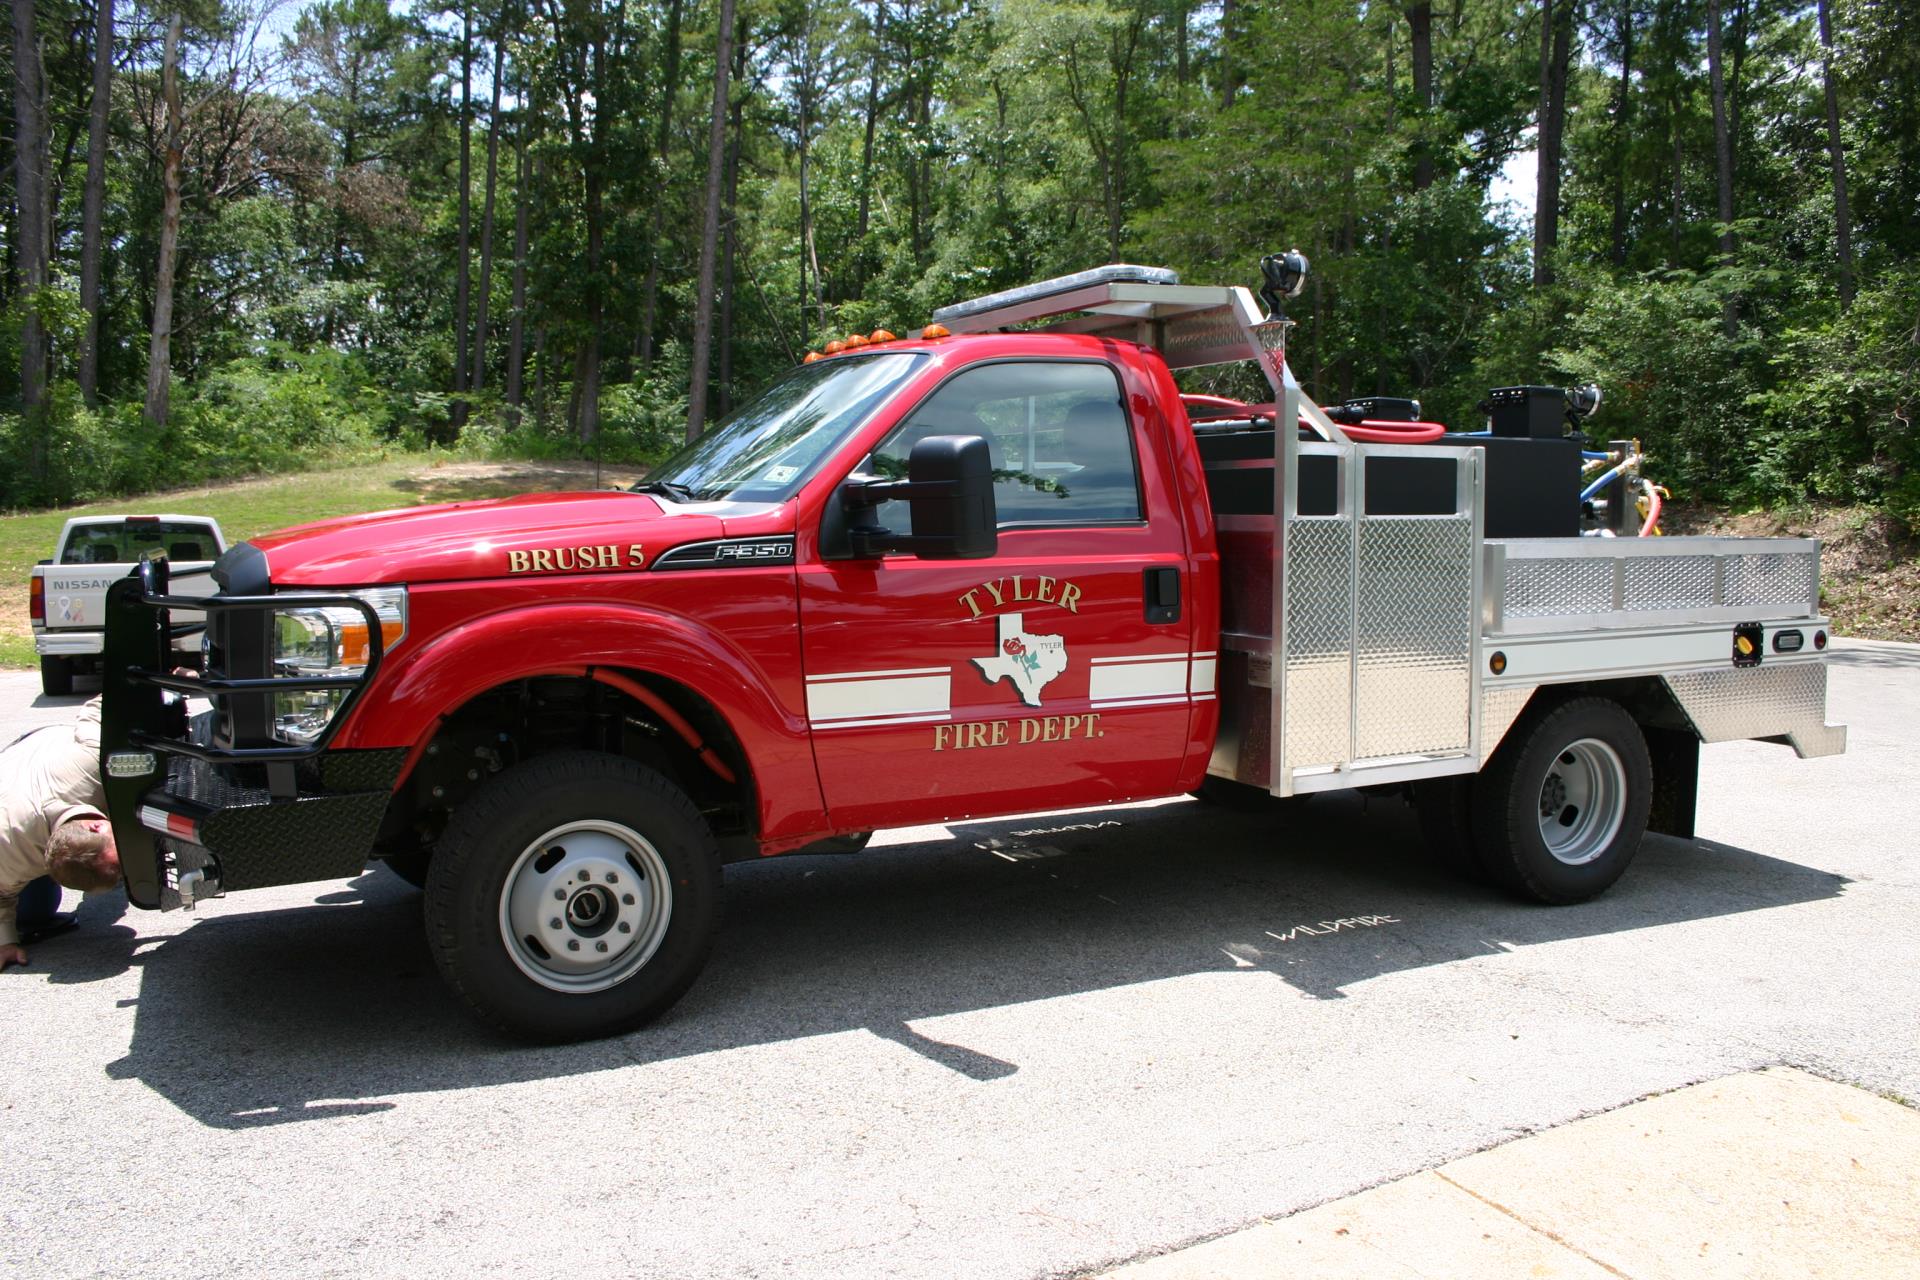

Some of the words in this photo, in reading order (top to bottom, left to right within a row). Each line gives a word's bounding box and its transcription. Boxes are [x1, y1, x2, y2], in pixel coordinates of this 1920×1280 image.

[508, 545, 622, 573] BRUSH
[628, 543, 645, 567] 5
[54, 580, 111, 590] NISSAN
[958, 575, 1082, 618] TYLER
[1040, 641, 1062, 650] TYLER
[933, 721, 1011, 751] FIRE
[1019, 714, 1105, 744] DEPT.
